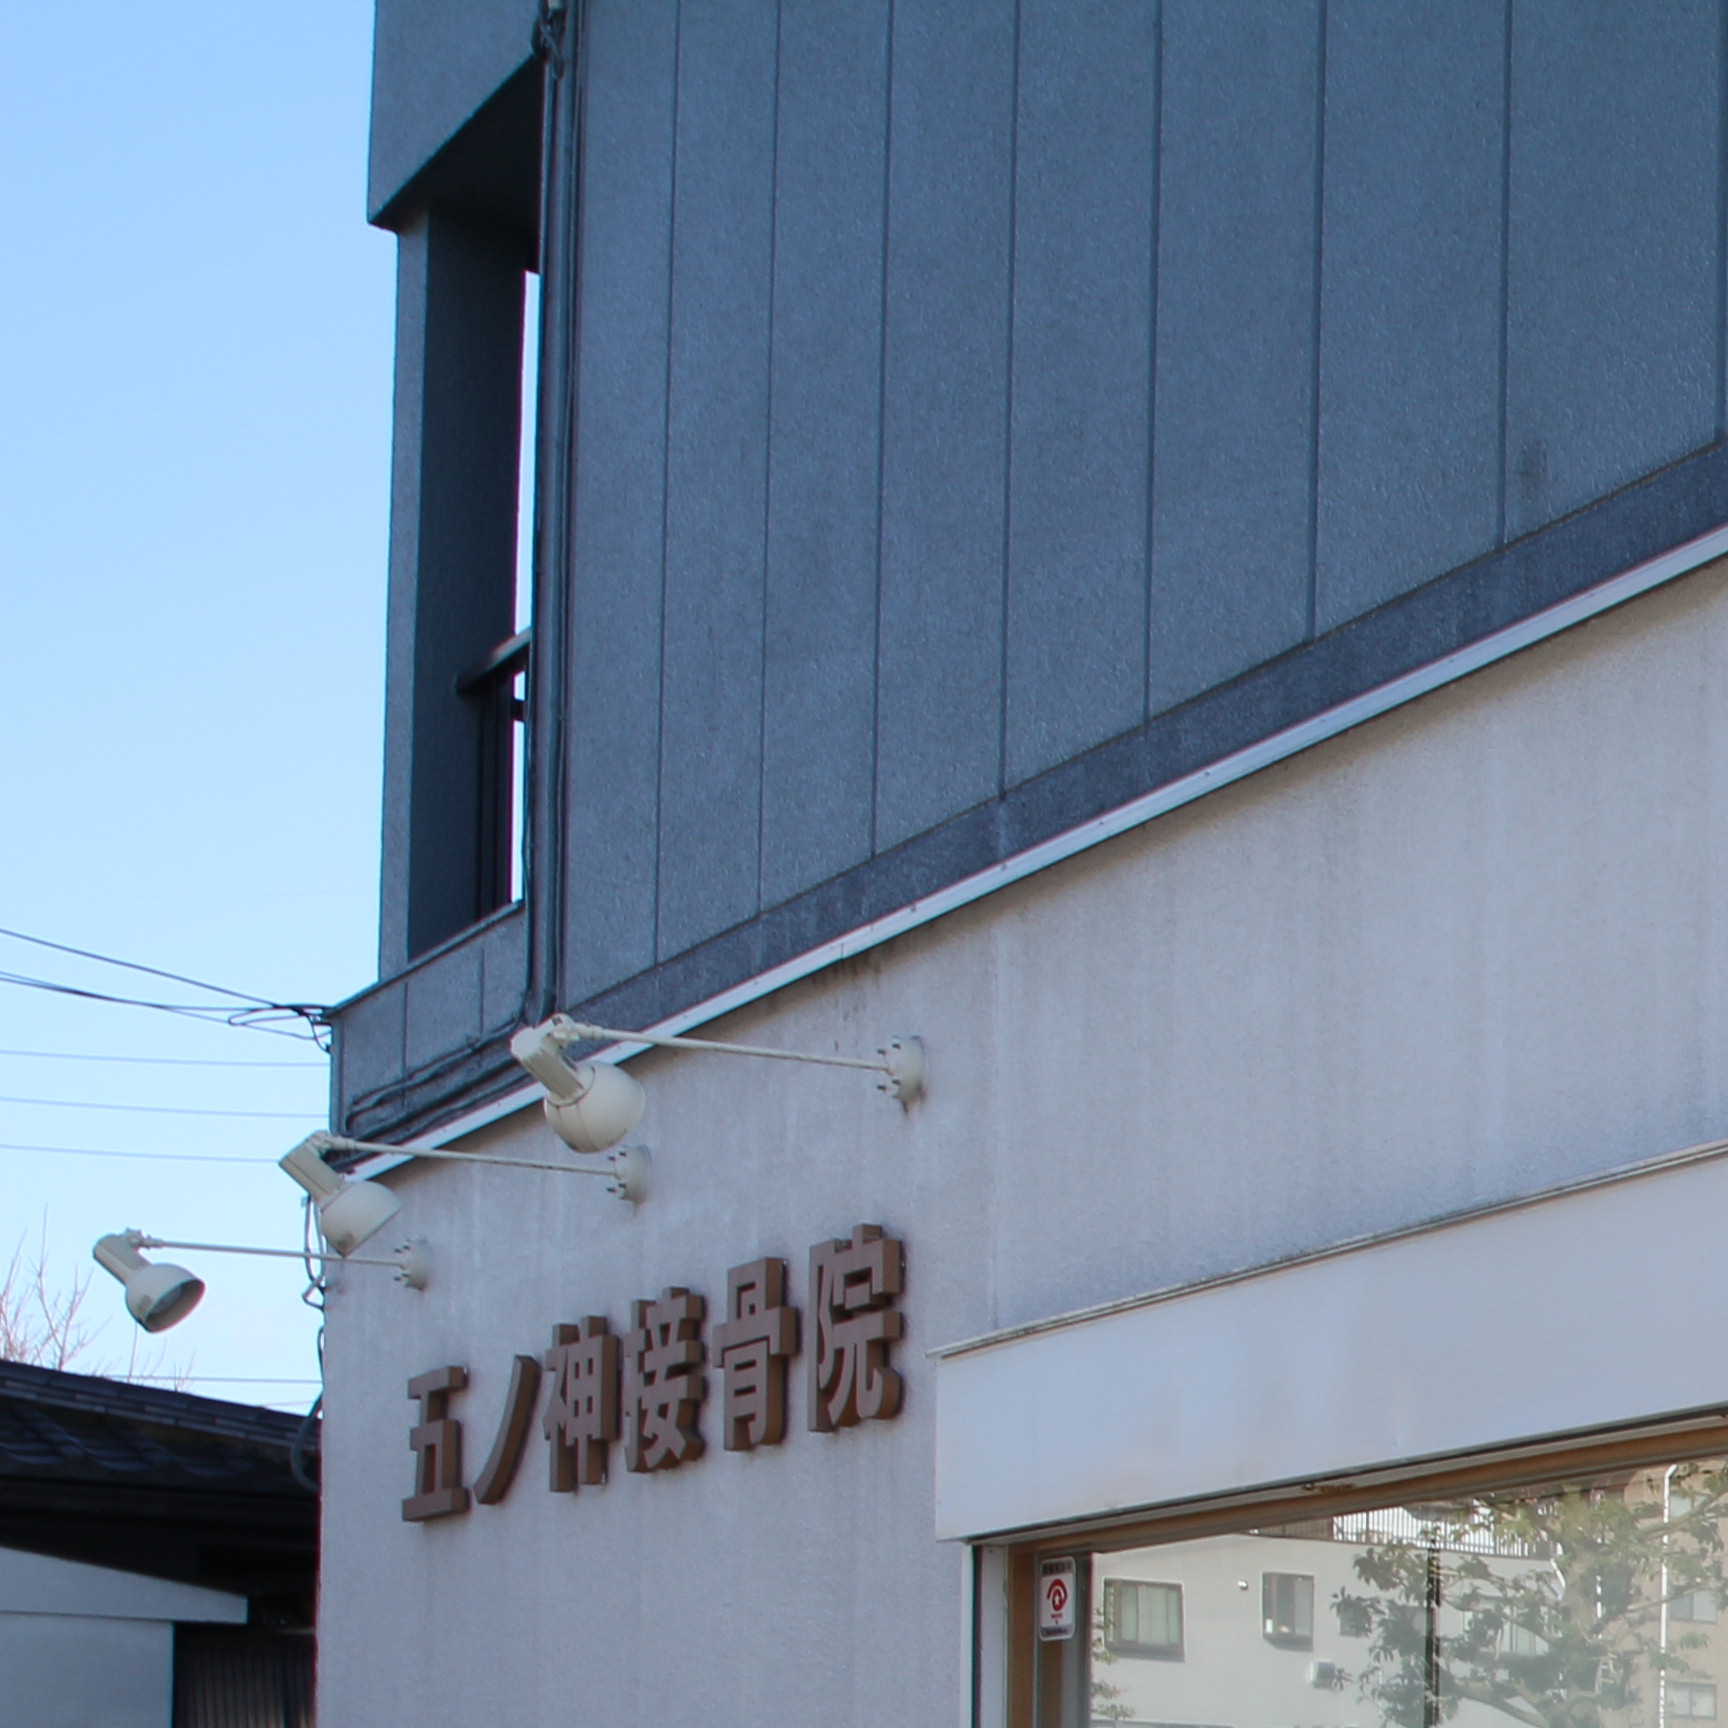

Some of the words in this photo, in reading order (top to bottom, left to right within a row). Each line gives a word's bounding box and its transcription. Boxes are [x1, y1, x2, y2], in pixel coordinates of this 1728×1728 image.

[402, 1224, 905, 1522] 五ノ神接骨院
